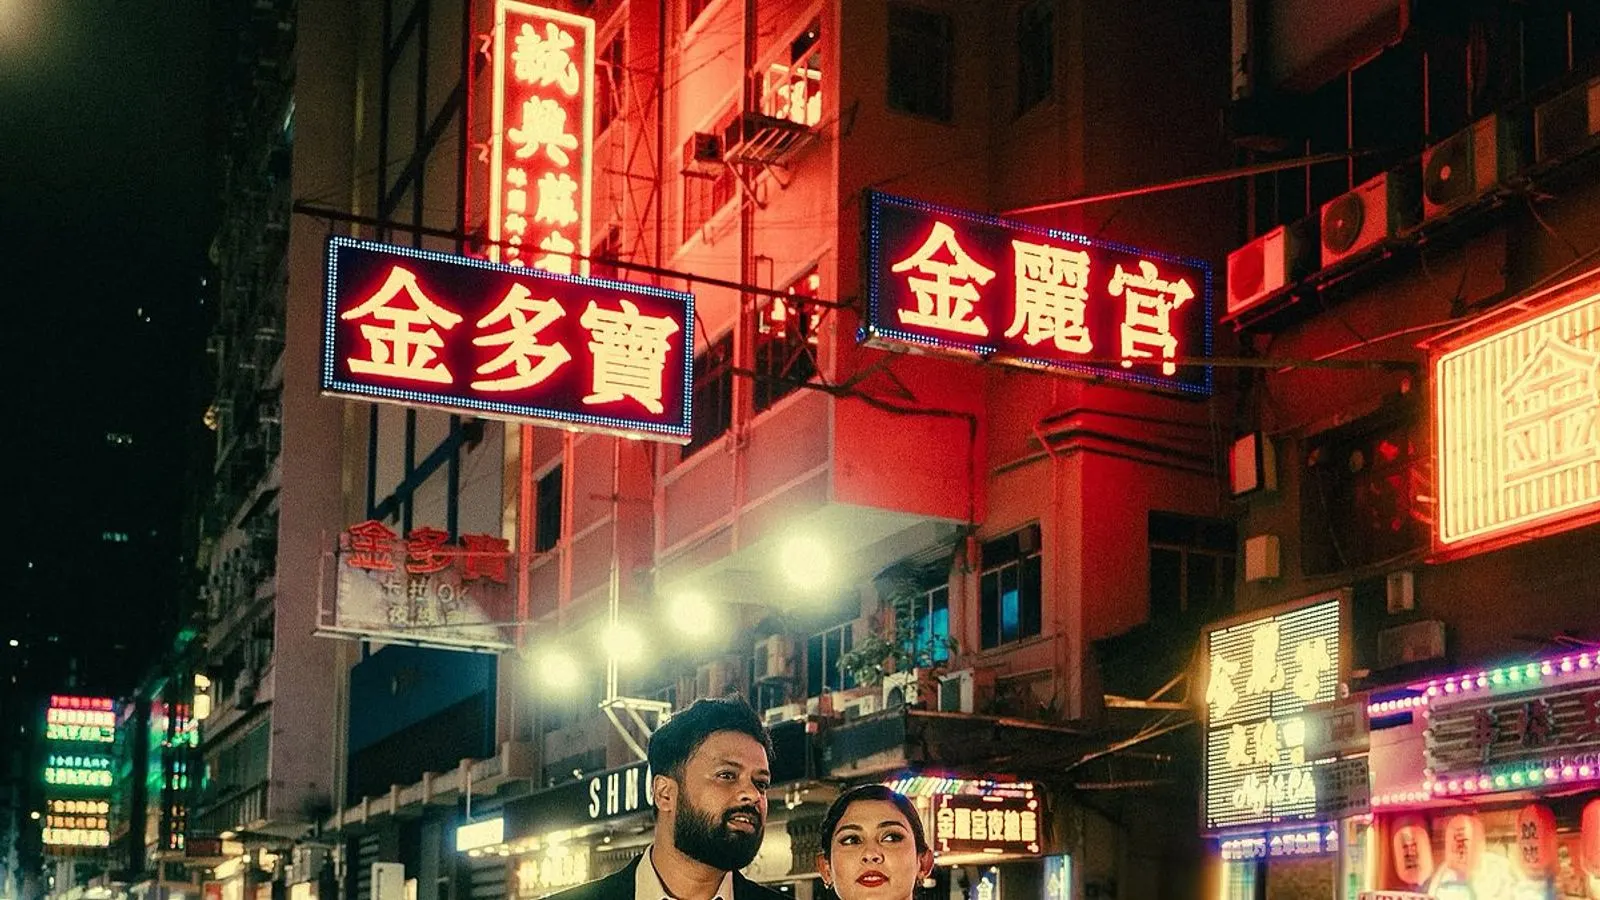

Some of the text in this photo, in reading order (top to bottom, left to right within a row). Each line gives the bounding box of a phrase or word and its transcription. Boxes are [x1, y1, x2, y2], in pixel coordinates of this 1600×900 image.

[341, 266, 679, 413] 金多寶
[892, 221, 1194, 375] 金麗宮
[347, 520, 510, 582] 金多寶
